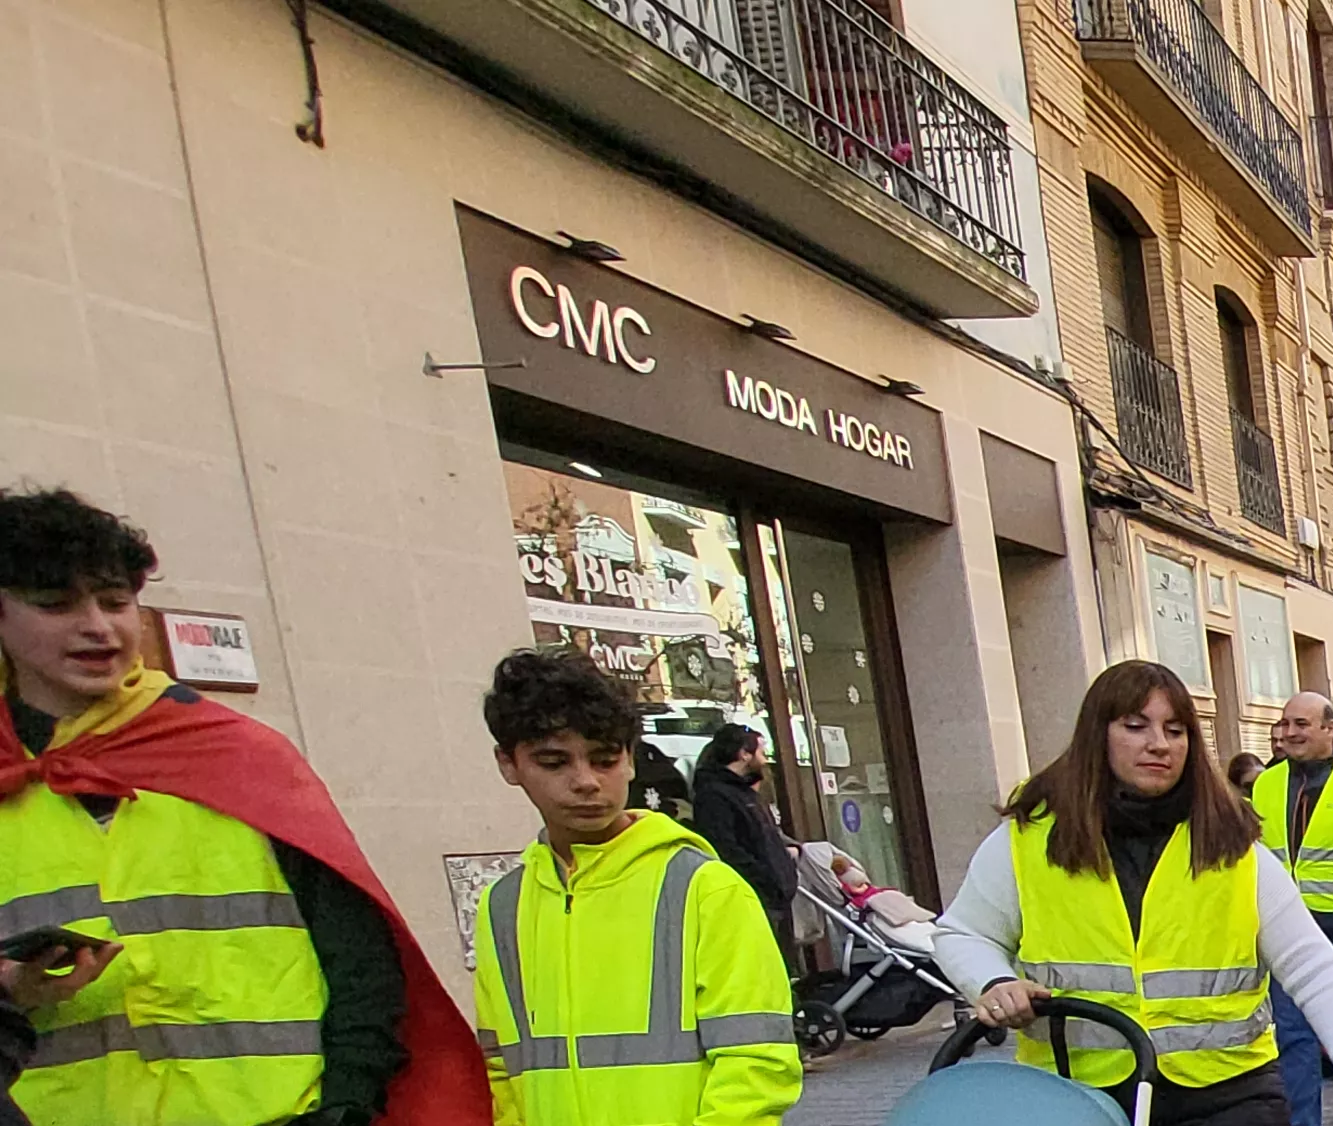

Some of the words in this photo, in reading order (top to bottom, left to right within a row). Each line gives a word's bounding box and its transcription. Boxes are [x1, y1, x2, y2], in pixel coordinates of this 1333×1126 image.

[510, 265, 657, 375] CMC
[724, 368, 819, 436] MODA
[826, 408, 915, 470] HOGAR
